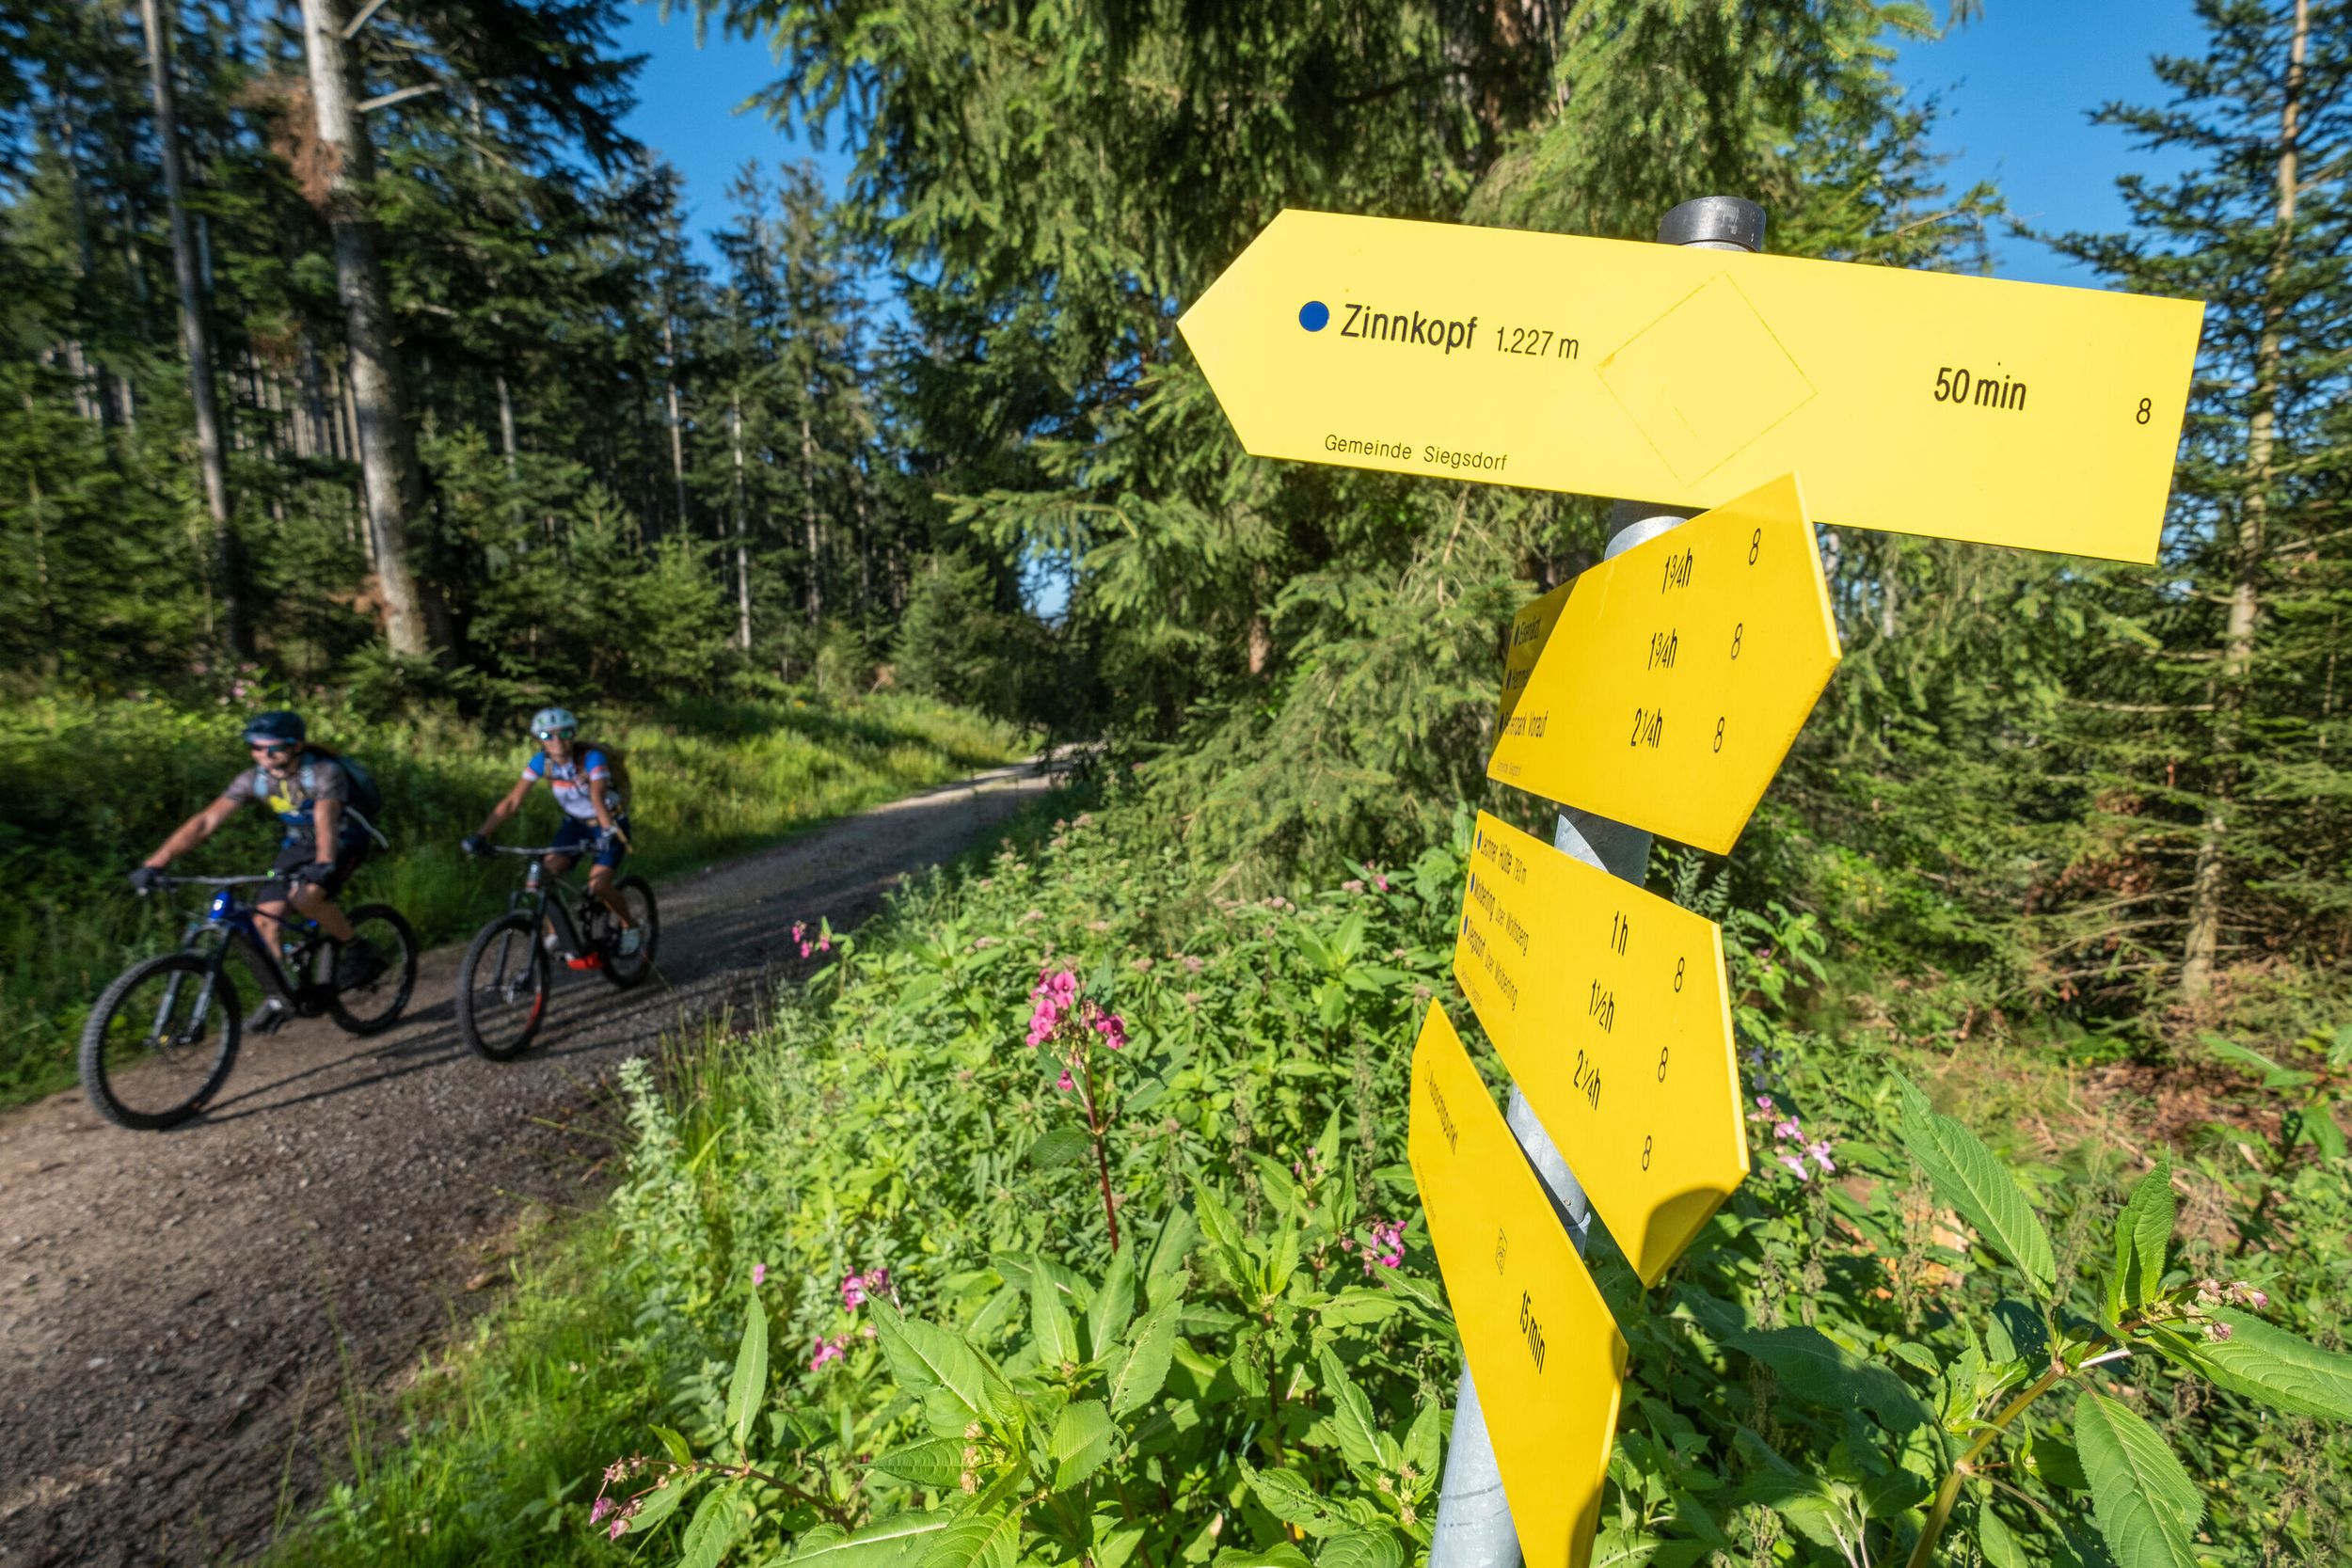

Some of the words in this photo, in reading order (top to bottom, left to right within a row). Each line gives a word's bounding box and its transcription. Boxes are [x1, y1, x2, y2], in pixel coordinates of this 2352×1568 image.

[1341, 304, 1477, 355] Zinnkopf
[1498, 326, 1553, 356] 1.227
[1559, 339, 1579, 359] m
[1934, 368, 1970, 404] 50
[1975, 375, 2026, 410] min
[2137, 398, 2152, 424] 8
[1326, 435, 1411, 459] Gemeinde
[1424, 446, 1506, 469] Siegsdorf
[1749, 528, 1760, 565] 8
[1731, 623, 1742, 660] 8
[1714, 717, 1724, 752] 8
[1675, 957, 1684, 992] 8
[1659, 1047, 1668, 1083] 8
[1643, 1135, 1652, 1171] 8
